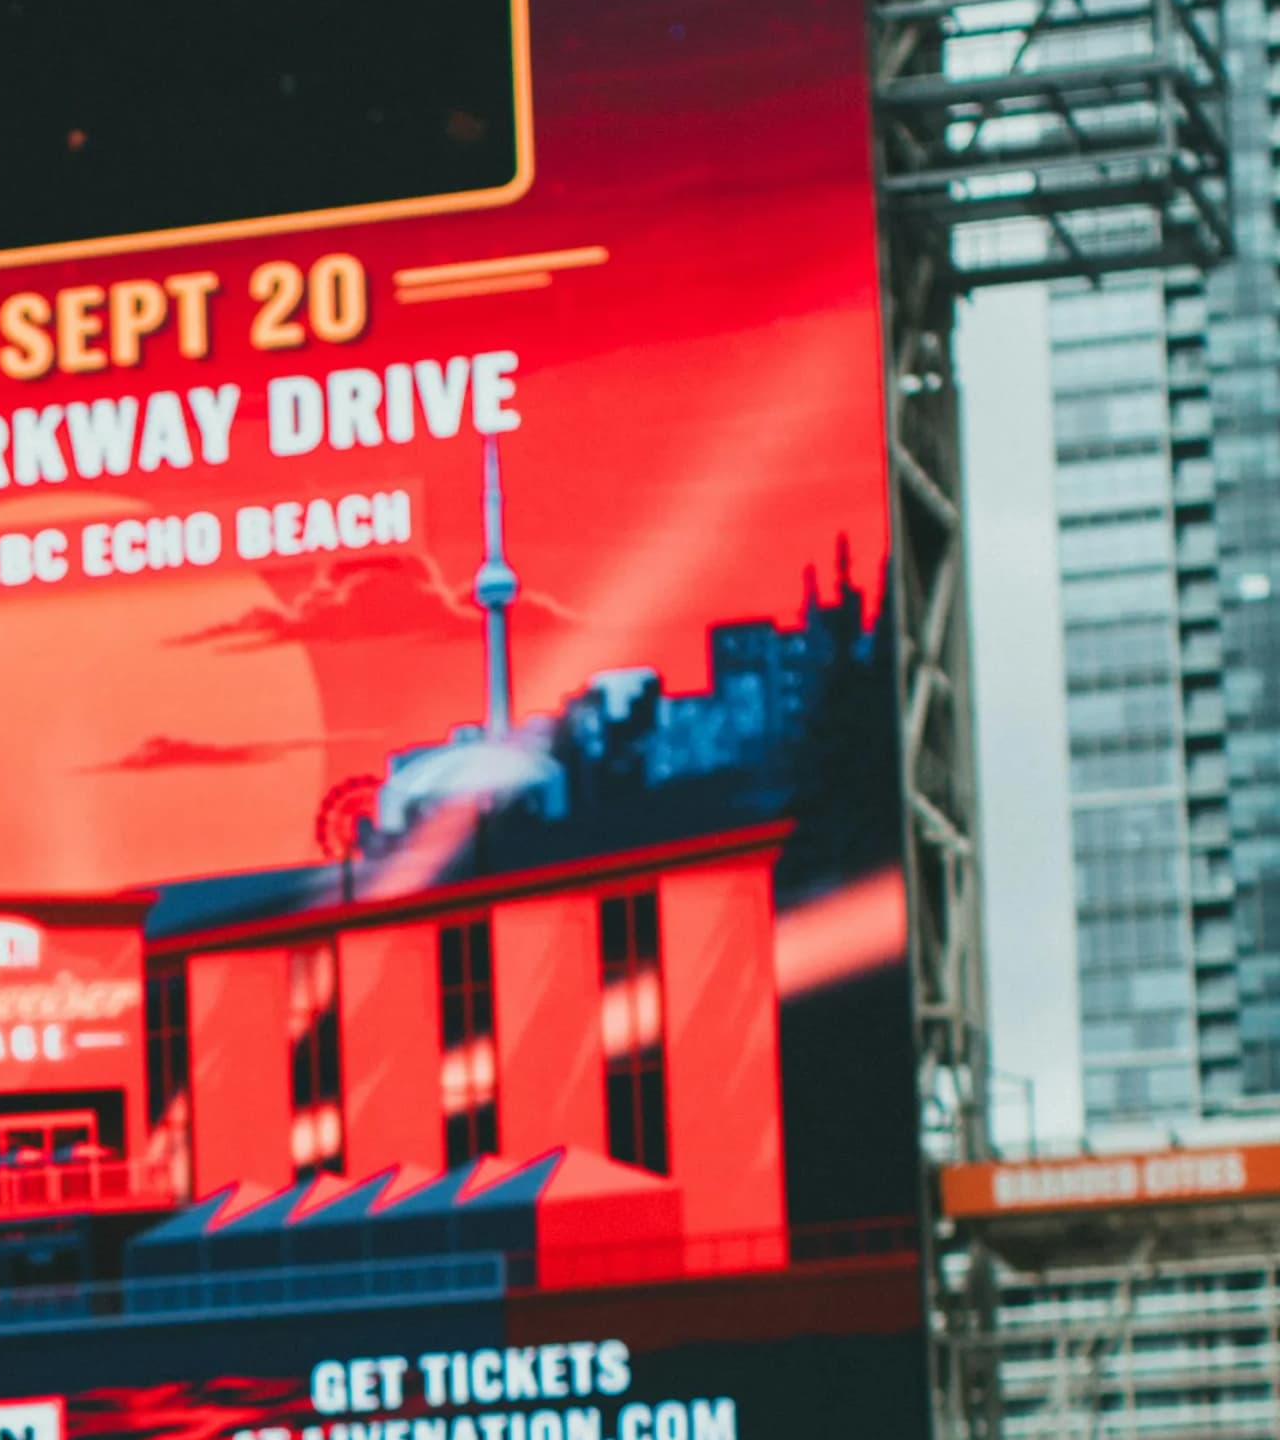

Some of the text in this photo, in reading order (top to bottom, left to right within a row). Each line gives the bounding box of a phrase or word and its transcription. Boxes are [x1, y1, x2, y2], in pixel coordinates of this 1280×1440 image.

[250, 254, 368, 349] 20
[267, 349, 522, 457] DRIVE
[80, 510, 223, 578] ECHO
[235, 488, 412, 561] BEACH
[309, 1338, 633, 1415] GET TICKETS
